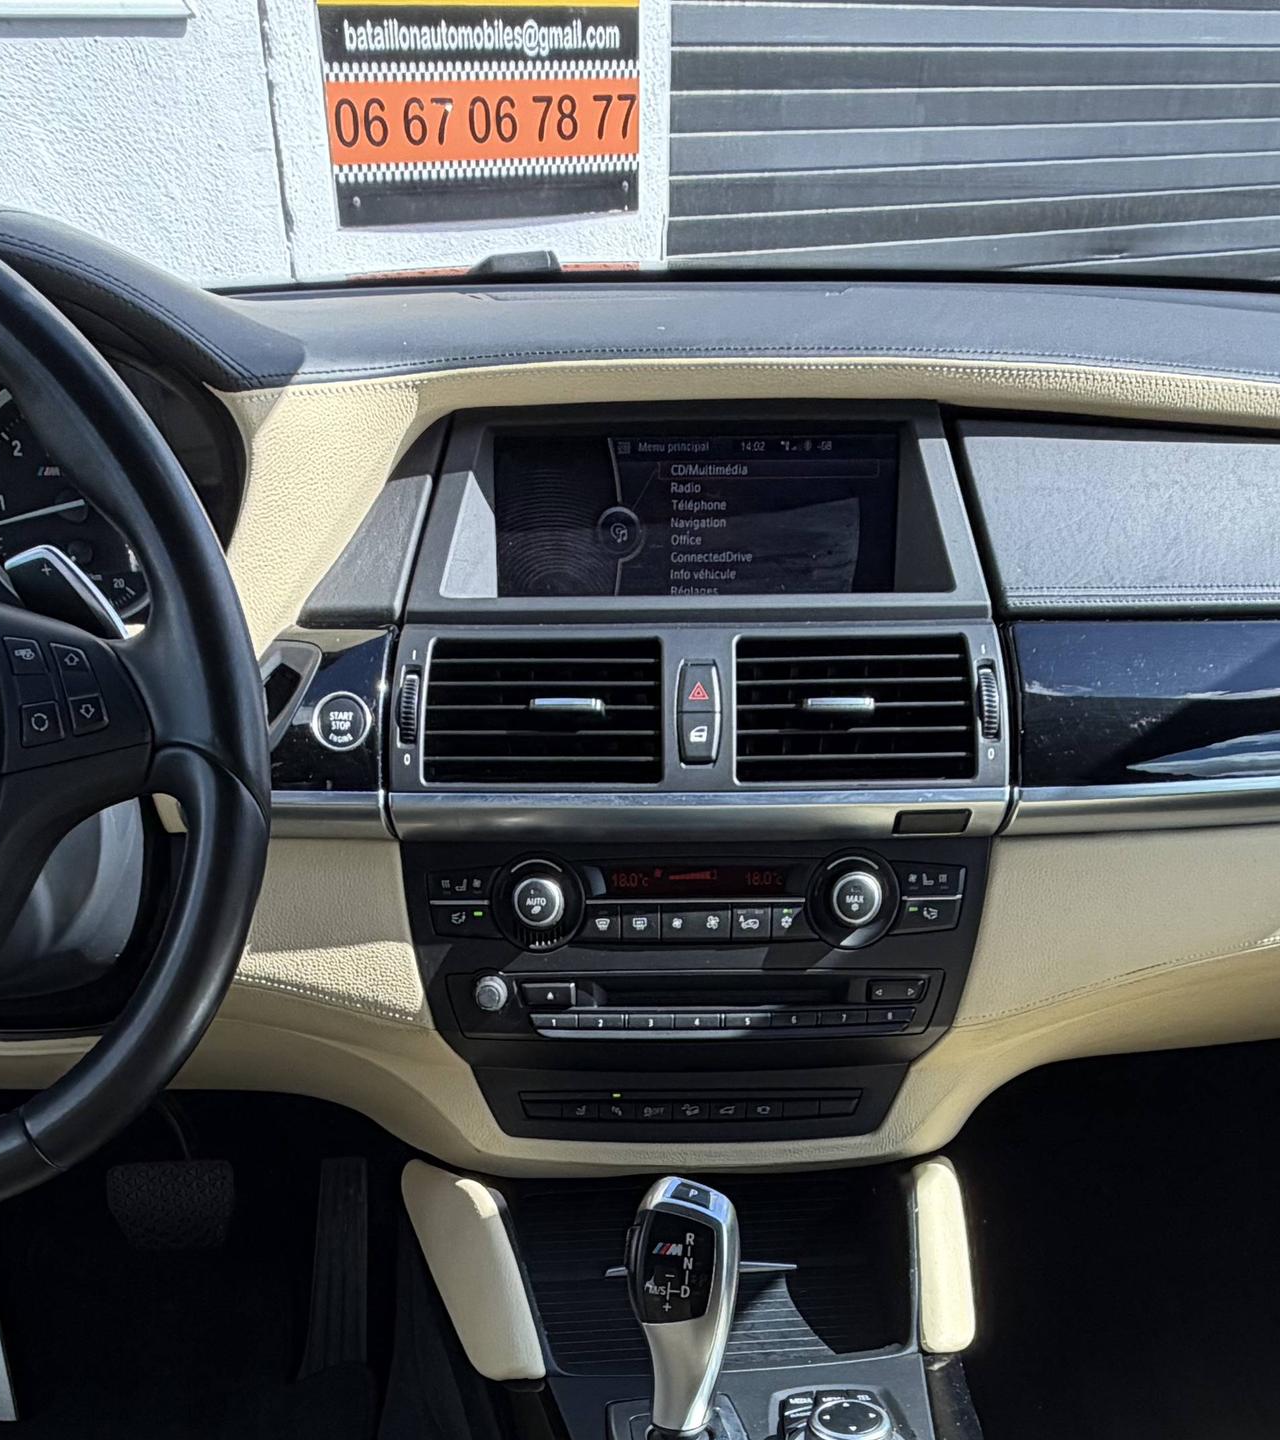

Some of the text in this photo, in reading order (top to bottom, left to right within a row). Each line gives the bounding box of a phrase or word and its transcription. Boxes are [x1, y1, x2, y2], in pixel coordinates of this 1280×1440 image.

[342, 16, 621, 57] bataillonautomobiles@gmail.com
[334, 93, 638, 148] 06 67 06 78 77
[12, 440, 23, 457] 2
[638, 442, 710, 453] Menu principal
[671, 463, 748, 476] CD/Multimédia
[671, 482, 701, 493] Radio
[672, 499, 727, 513] Téléphone
[671, 517, 726, 530] Navigation
[671, 533, 702, 546] Office
[671, 551, 753, 563] ConnectedDrive
[670, 568, 737, 580] Info véhicule
[113, 578, 125, 588] 20
[329, 711, 354, 721] START
[331, 721, 351, 731] STOP
[525, 897, 547, 907] AUTO
[845, 894, 865, 904] MAX
[688, 1188, 699, 1198] P
[685, 1232, 695, 1245] R
[683, 1257, 693, 1270] N
[680, 1285, 691, 1298] D
